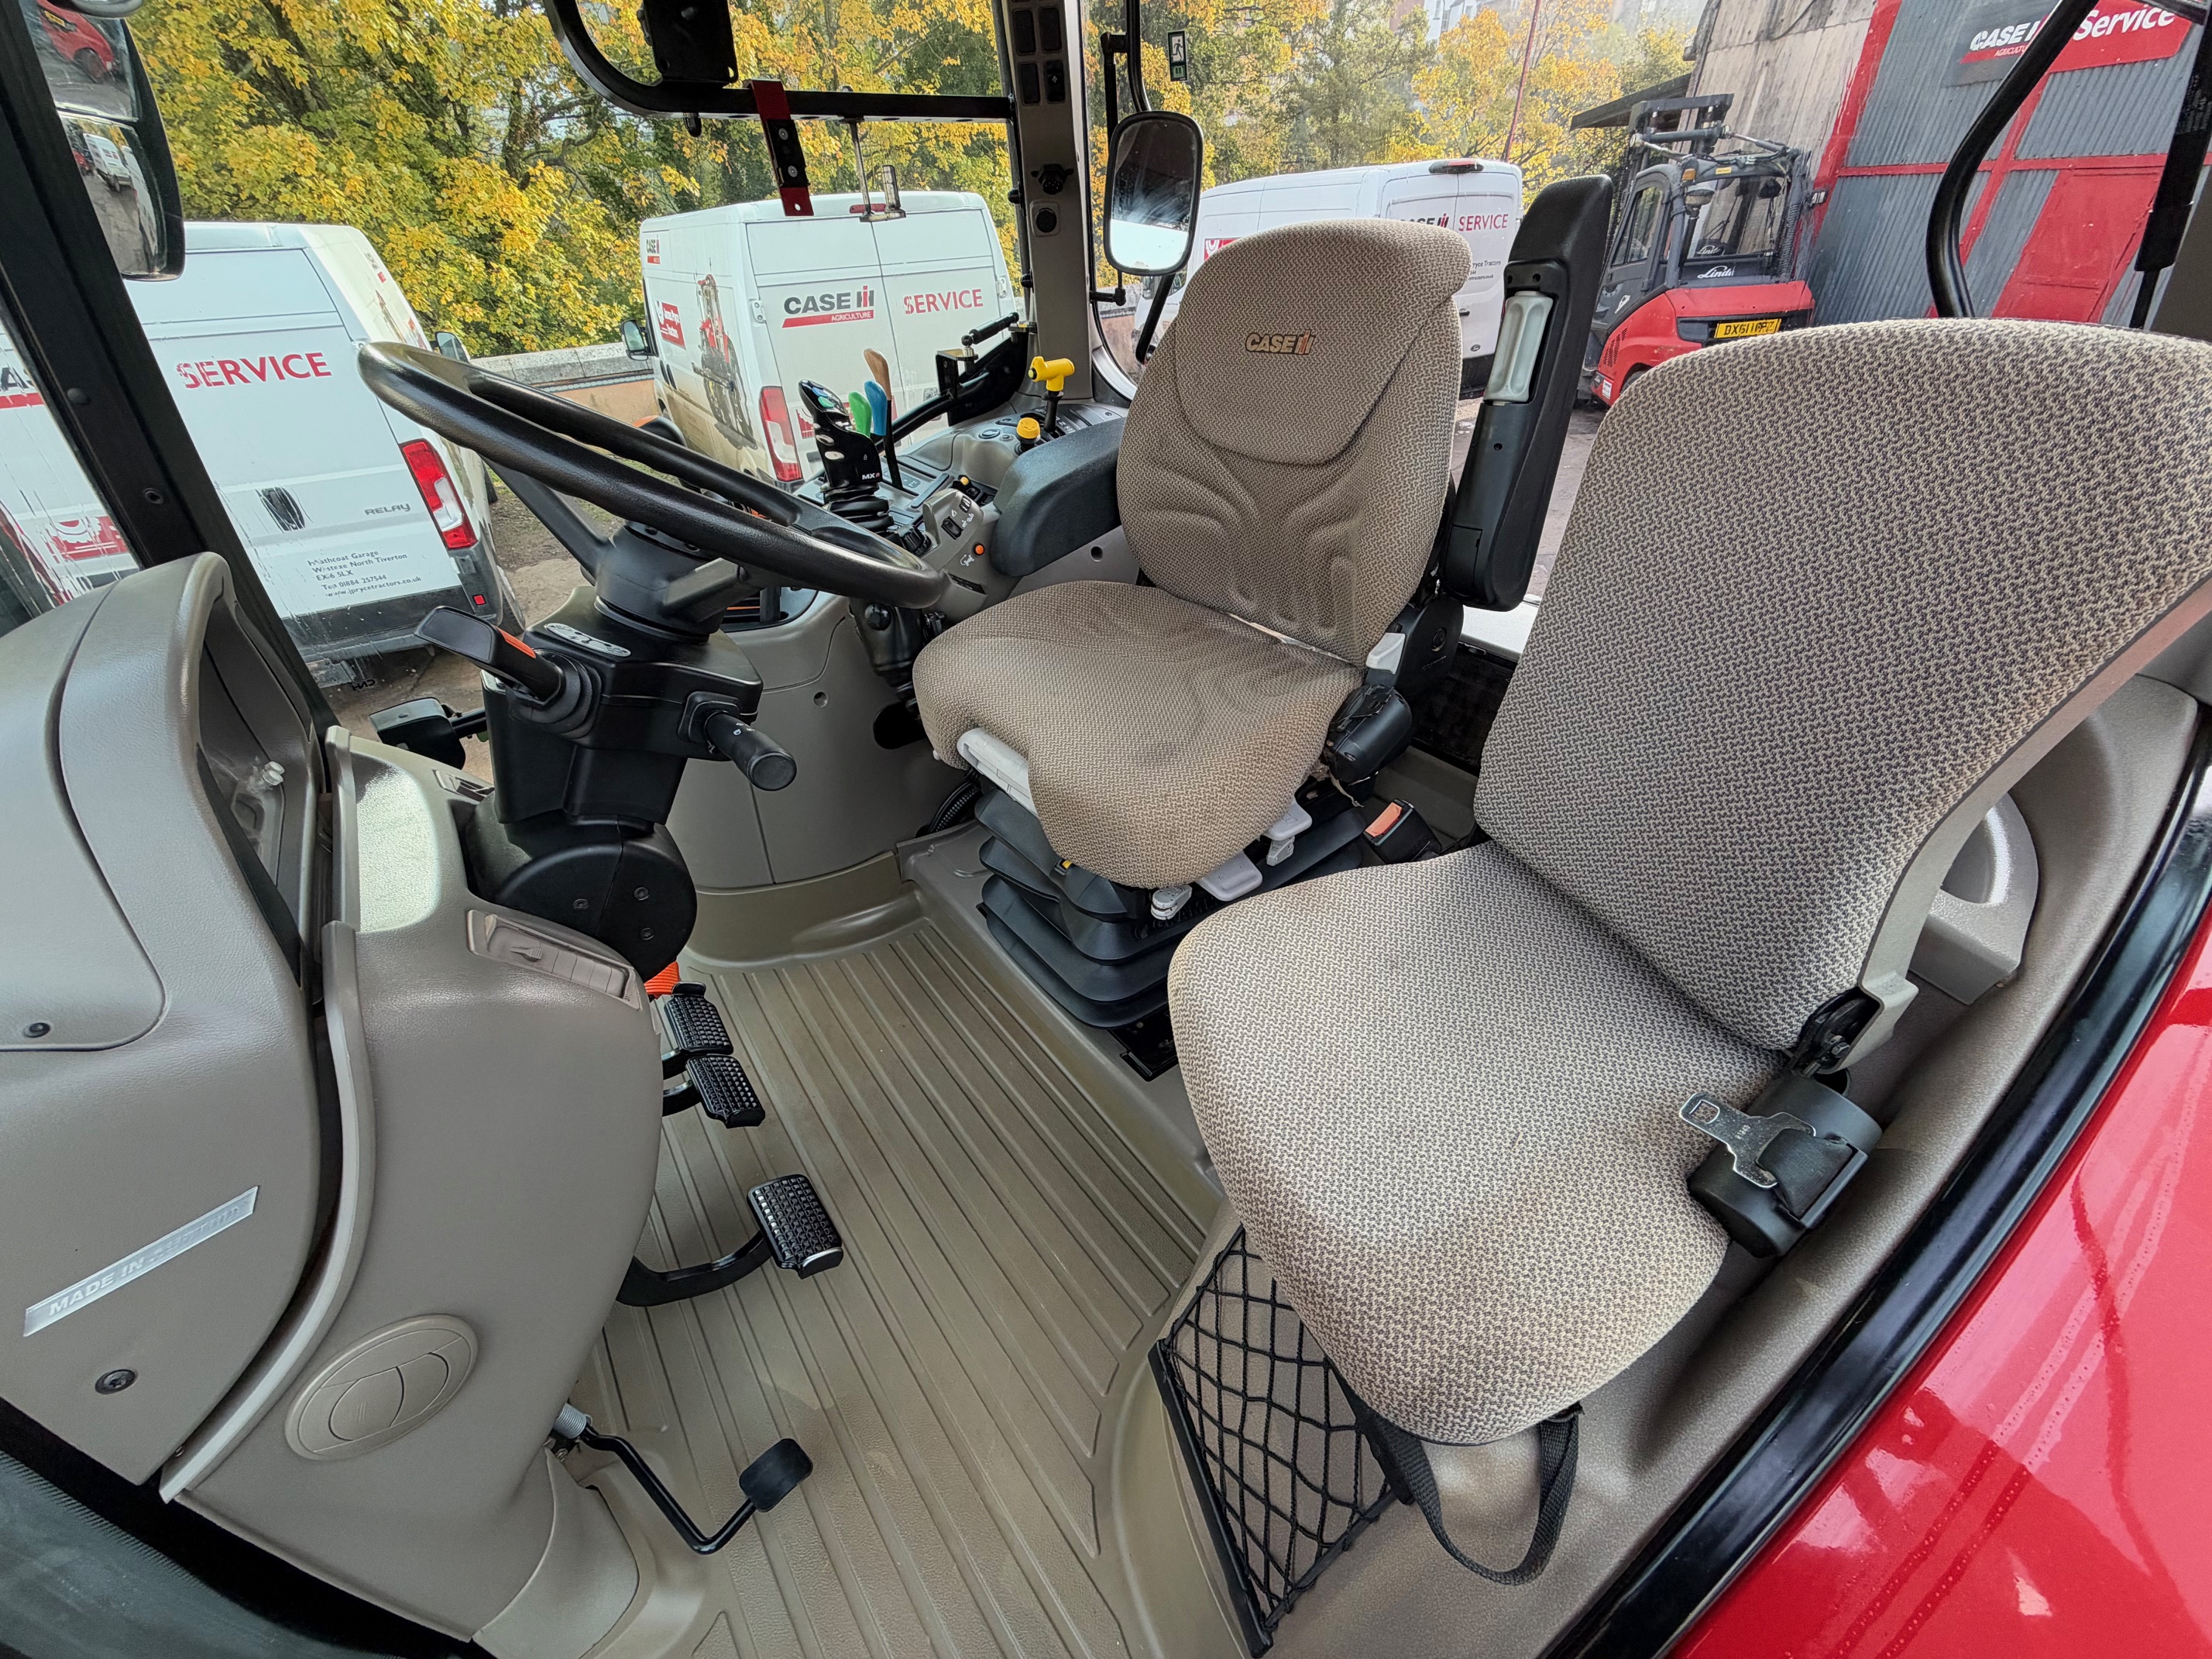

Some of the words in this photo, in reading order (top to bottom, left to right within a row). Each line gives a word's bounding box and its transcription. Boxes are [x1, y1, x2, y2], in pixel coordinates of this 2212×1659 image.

[2073, 5, 2175, 41] Service
[1970, 22, 2031, 51] CASE
[1994, 45, 2027, 57] AGRICULTU
[1458, 214, 1509, 232] SERVICE
[784, 292, 850, 314] CASE
[903, 289, 983, 314] SERVICE
[831, 311, 871, 321] AGRICULTURE
[1245, 332, 1297, 353] CASE
[176, 352, 332, 389] SERVICE
[364, 503, 410, 515] RELAY
[351, 551, 380, 560] Garage
[376, 553, 407, 563] Tiverton
[338, 579, 359, 588] 01884
[361, 575, 387, 584] 257544
[49, 1272, 115, 1316] MADE
[121, 1256, 145, 1277] IN
